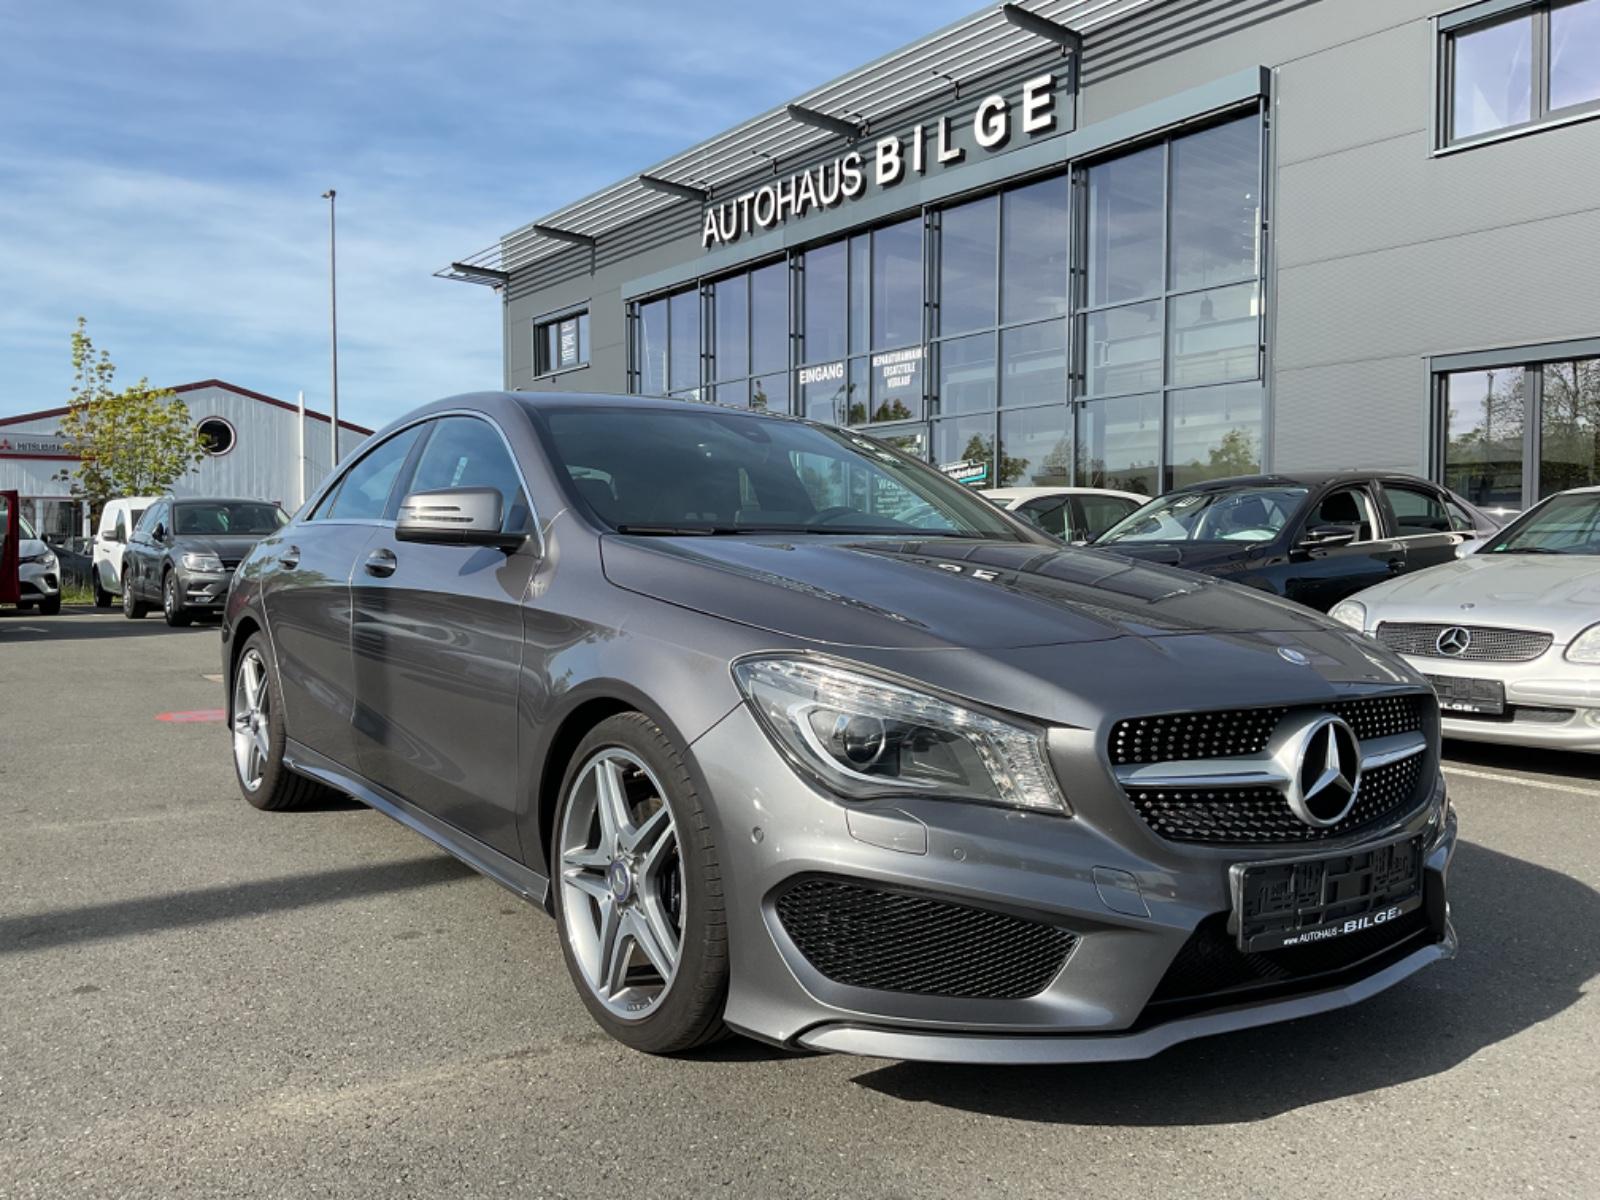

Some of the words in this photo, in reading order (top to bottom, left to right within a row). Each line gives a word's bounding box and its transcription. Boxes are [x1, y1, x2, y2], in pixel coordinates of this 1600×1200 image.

[701, 151, 863, 248] AUTOHAUS
[875, 73, 1053, 186] BILGE
[799, 363, 844, 385] EINGANG
